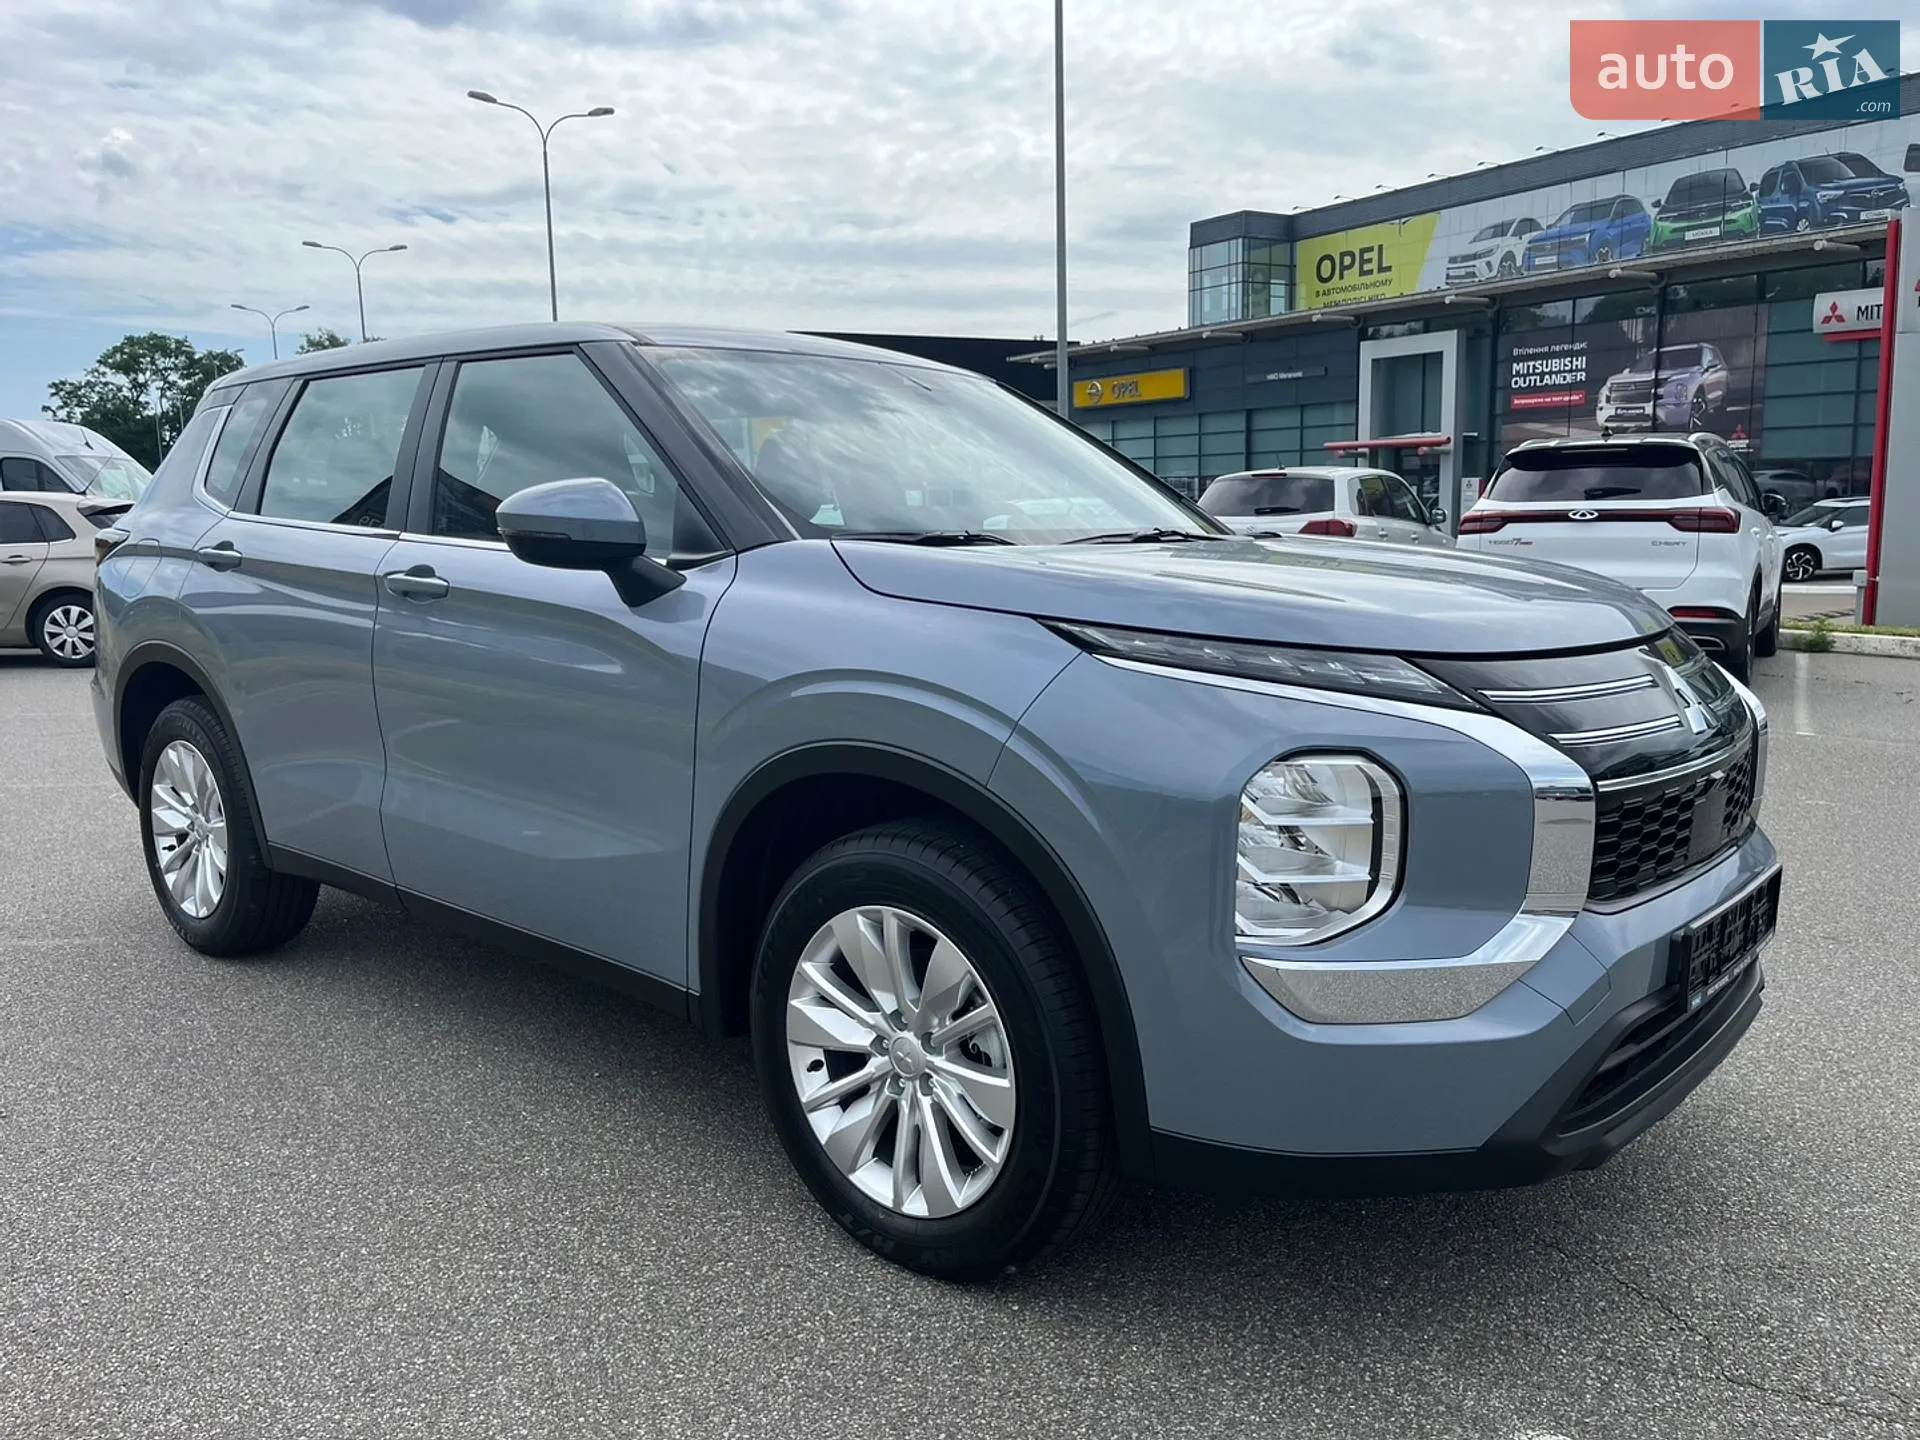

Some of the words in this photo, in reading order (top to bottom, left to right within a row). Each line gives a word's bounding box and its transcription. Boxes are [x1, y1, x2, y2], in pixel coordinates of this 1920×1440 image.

[1315, 244, 1393, 284] OPEL
[1321, 279, 1393, 297] АВТОМОБІЛЬНОМУ
[1512, 356, 1587, 375] MITSUBISHI
[1511, 371, 1587, 388] OUTLANDER
[1112, 380, 1141, 399] OPEL
